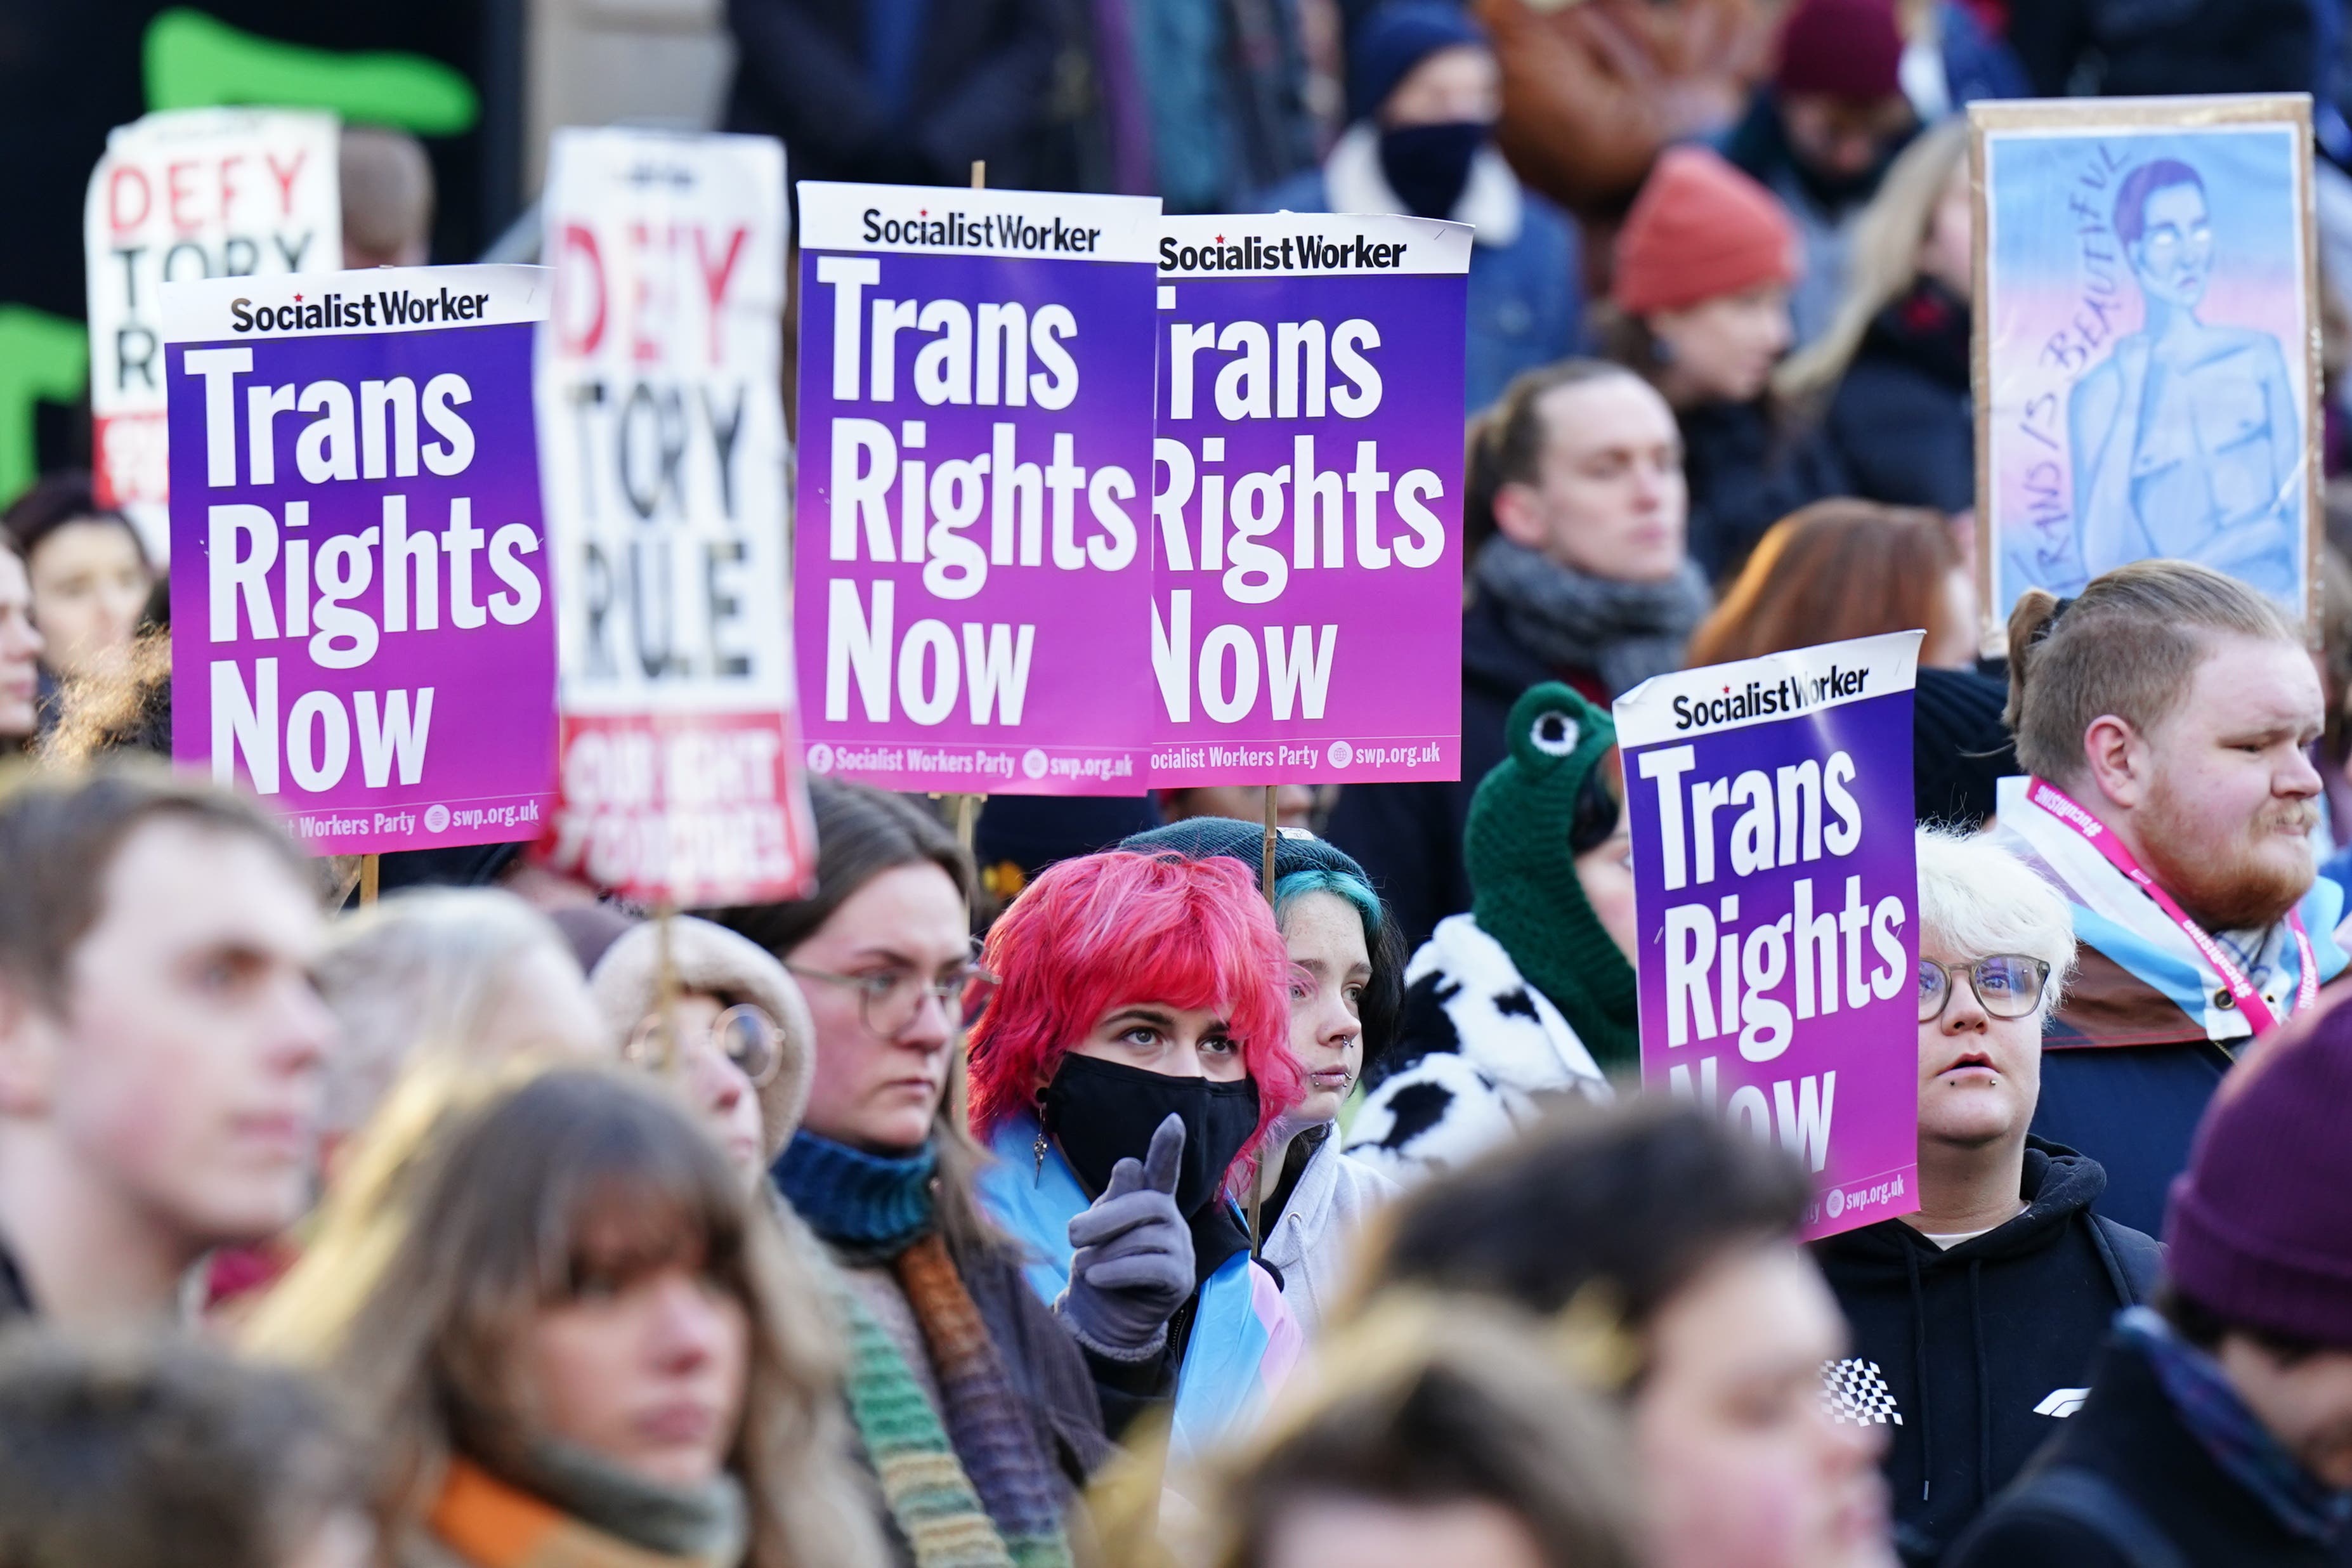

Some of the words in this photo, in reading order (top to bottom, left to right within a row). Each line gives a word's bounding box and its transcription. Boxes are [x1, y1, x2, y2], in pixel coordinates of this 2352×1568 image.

[109, 146, 307, 235] DEFY
[2037, 142, 2132, 381] BEAUTIFUL
[556, 219, 751, 368] DEY
[817, 256, 1079, 411] Trans
[184, 347, 476, 487] Trans
[209, 494, 542, 670] Rights
[830, 417, 1138, 601] Rights
[1153, 434, 1446, 604] Rights
[2008, 462, 2089, 591] TRANS
[209, 657, 434, 794] Now
[825, 578, 1036, 726] Now
[299, 811, 370, 839] Workers
[374, 811, 416, 836] Party
[452, 799, 539, 830] swp.org.uk
[835, 747, 904, 772] Socialist
[906, 748, 974, 774] Workers
[975, 750, 1016, 780] Party
[1050, 754, 1134, 781] swp.org.uk
[1150, 747, 1206, 770] ocialist
[1208, 746, 1275, 769] Workers
[1278, 745, 1319, 770] Party
[1356, 741, 1441, 769] swp.org.uk
[1638, 744, 1862, 891] Trans
[1665, 875, 1907, 1062] Rights
[1846, 1174, 1905, 1212] swp.org.uk
